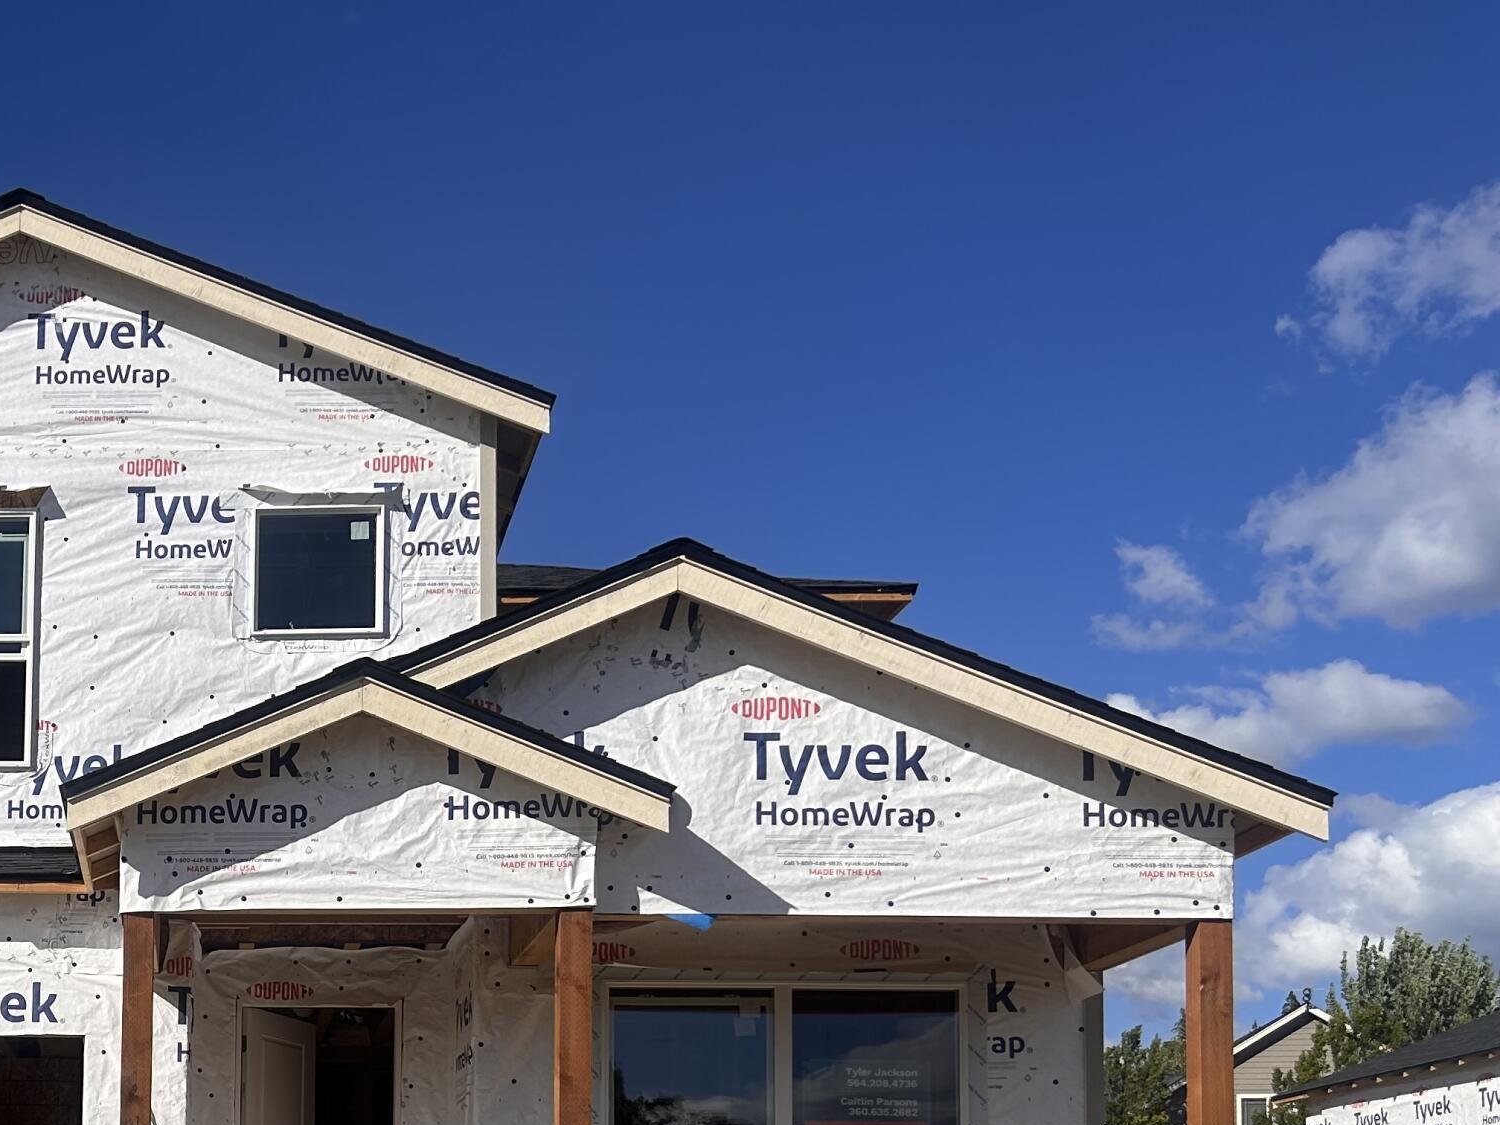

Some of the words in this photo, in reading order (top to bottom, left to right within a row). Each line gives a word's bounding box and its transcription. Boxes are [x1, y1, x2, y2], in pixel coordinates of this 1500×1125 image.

[28, 310, 167, 362] Tyvek
[35, 365, 170, 388] HomeWrap
[127, 458, 180, 477] DUPONT
[373, 455, 427, 474] DUPONT
[135, 539, 233, 559] HomeW
[742, 697, 812, 720] DUPONT
[744, 731, 929, 795] Tyvek
[137, 798, 309, 829] HomeWrap
[755, 800, 936, 833] HomeWrap
[501, 860, 526, 870] MADE
[528, 860, 536, 870] IN
[538, 860, 555, 870] THE
[557, 860, 574, 870] USA
[809, 868, 834, 878] MADE
[836, 868, 845, 878] IN
[848, 868, 862, 878] THE
[864, 868, 882, 878] USA
[1139, 870, 1164, 880] MADE
[1166, 870, 1176, 880] IN
[1178, 870, 1195, 880] THE
[1196, 870, 1215, 880] USA
[850, 939, 912, 961] DUPONT
[845, 1067, 872, 1078] Tyler
[874, 1067, 918, 1077] Jackson
[876, 1098, 918, 1107] Parsons
[1413, 1095, 1451, 1123] Tyvek
